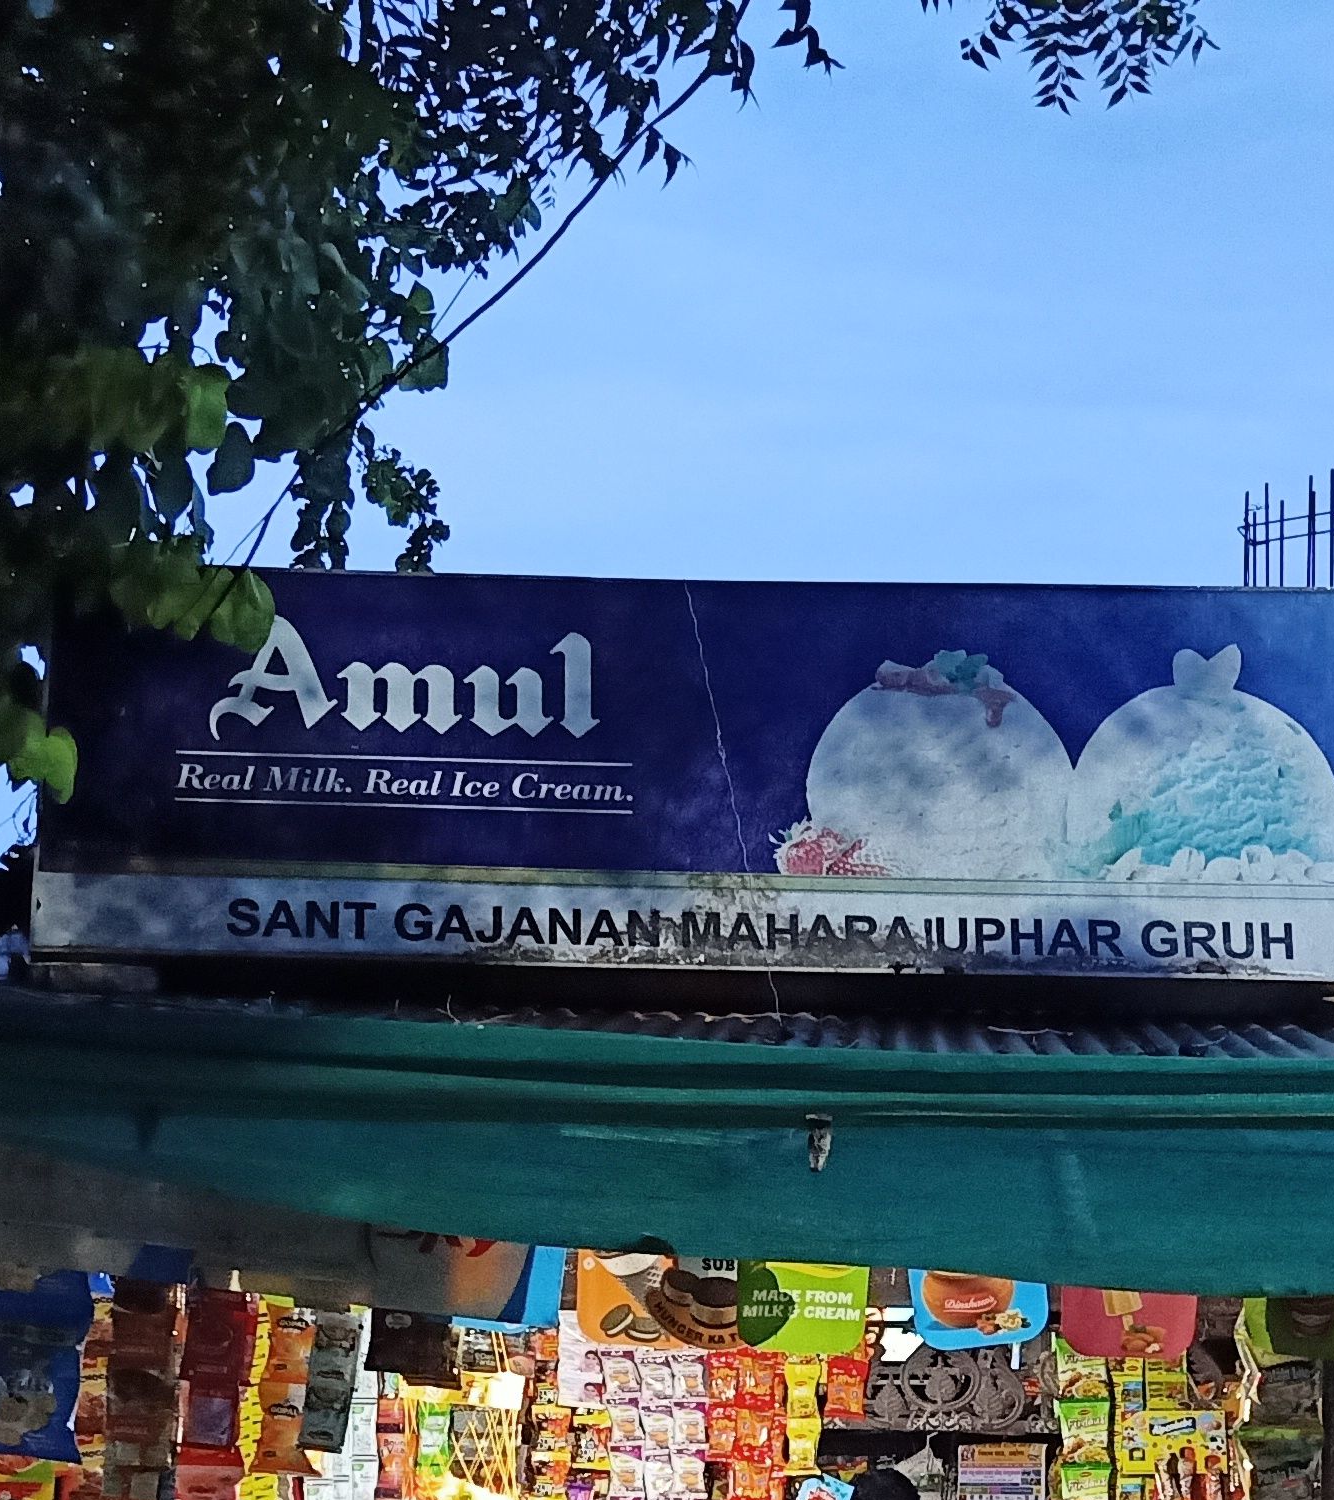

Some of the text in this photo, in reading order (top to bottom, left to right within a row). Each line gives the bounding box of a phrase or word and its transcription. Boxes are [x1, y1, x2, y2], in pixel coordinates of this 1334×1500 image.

[209, 614, 601, 741] Amul
[176, 762, 635, 803] Real Milk. Real Ice Cream.
[226, 897, 376, 940] SANT
[393, 903, 661, 949] GAJANAN
[1141, 919, 1294, 960] GRUH
[701, 1257, 737, 1271] SUB
[752, 1288, 854, 1305] MADE FROM
[742, 1304, 783, 1318] MILK
[803, 1305, 862, 1322] CREAM
